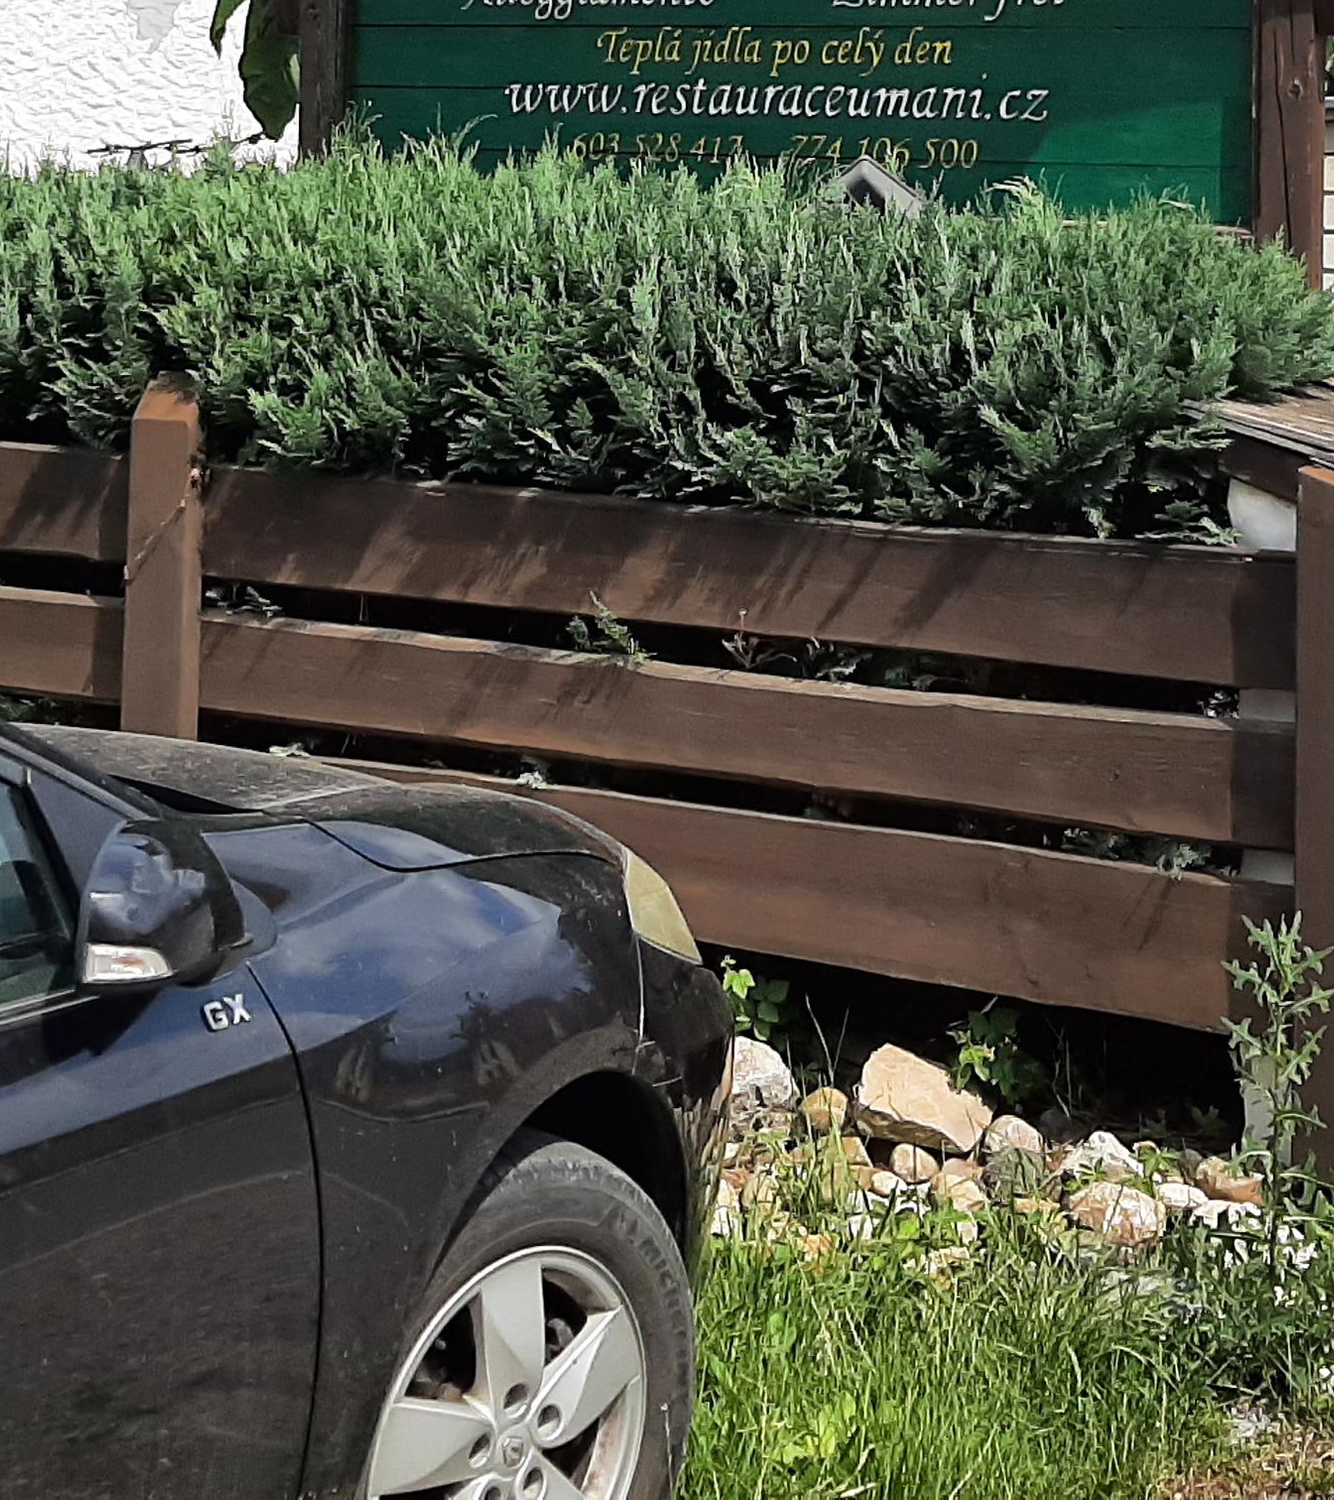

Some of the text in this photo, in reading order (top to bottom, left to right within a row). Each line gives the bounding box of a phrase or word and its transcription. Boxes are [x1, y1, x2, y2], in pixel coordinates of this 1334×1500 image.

[597, 27, 953, 77] Teplá jídla po celý den
[505, 73, 1049, 121] www.restauraceumani.cz
[630, 132, 681, 162] 528
[918, 138, 978, 169] 500
[203, 993, 251, 1031] GX
